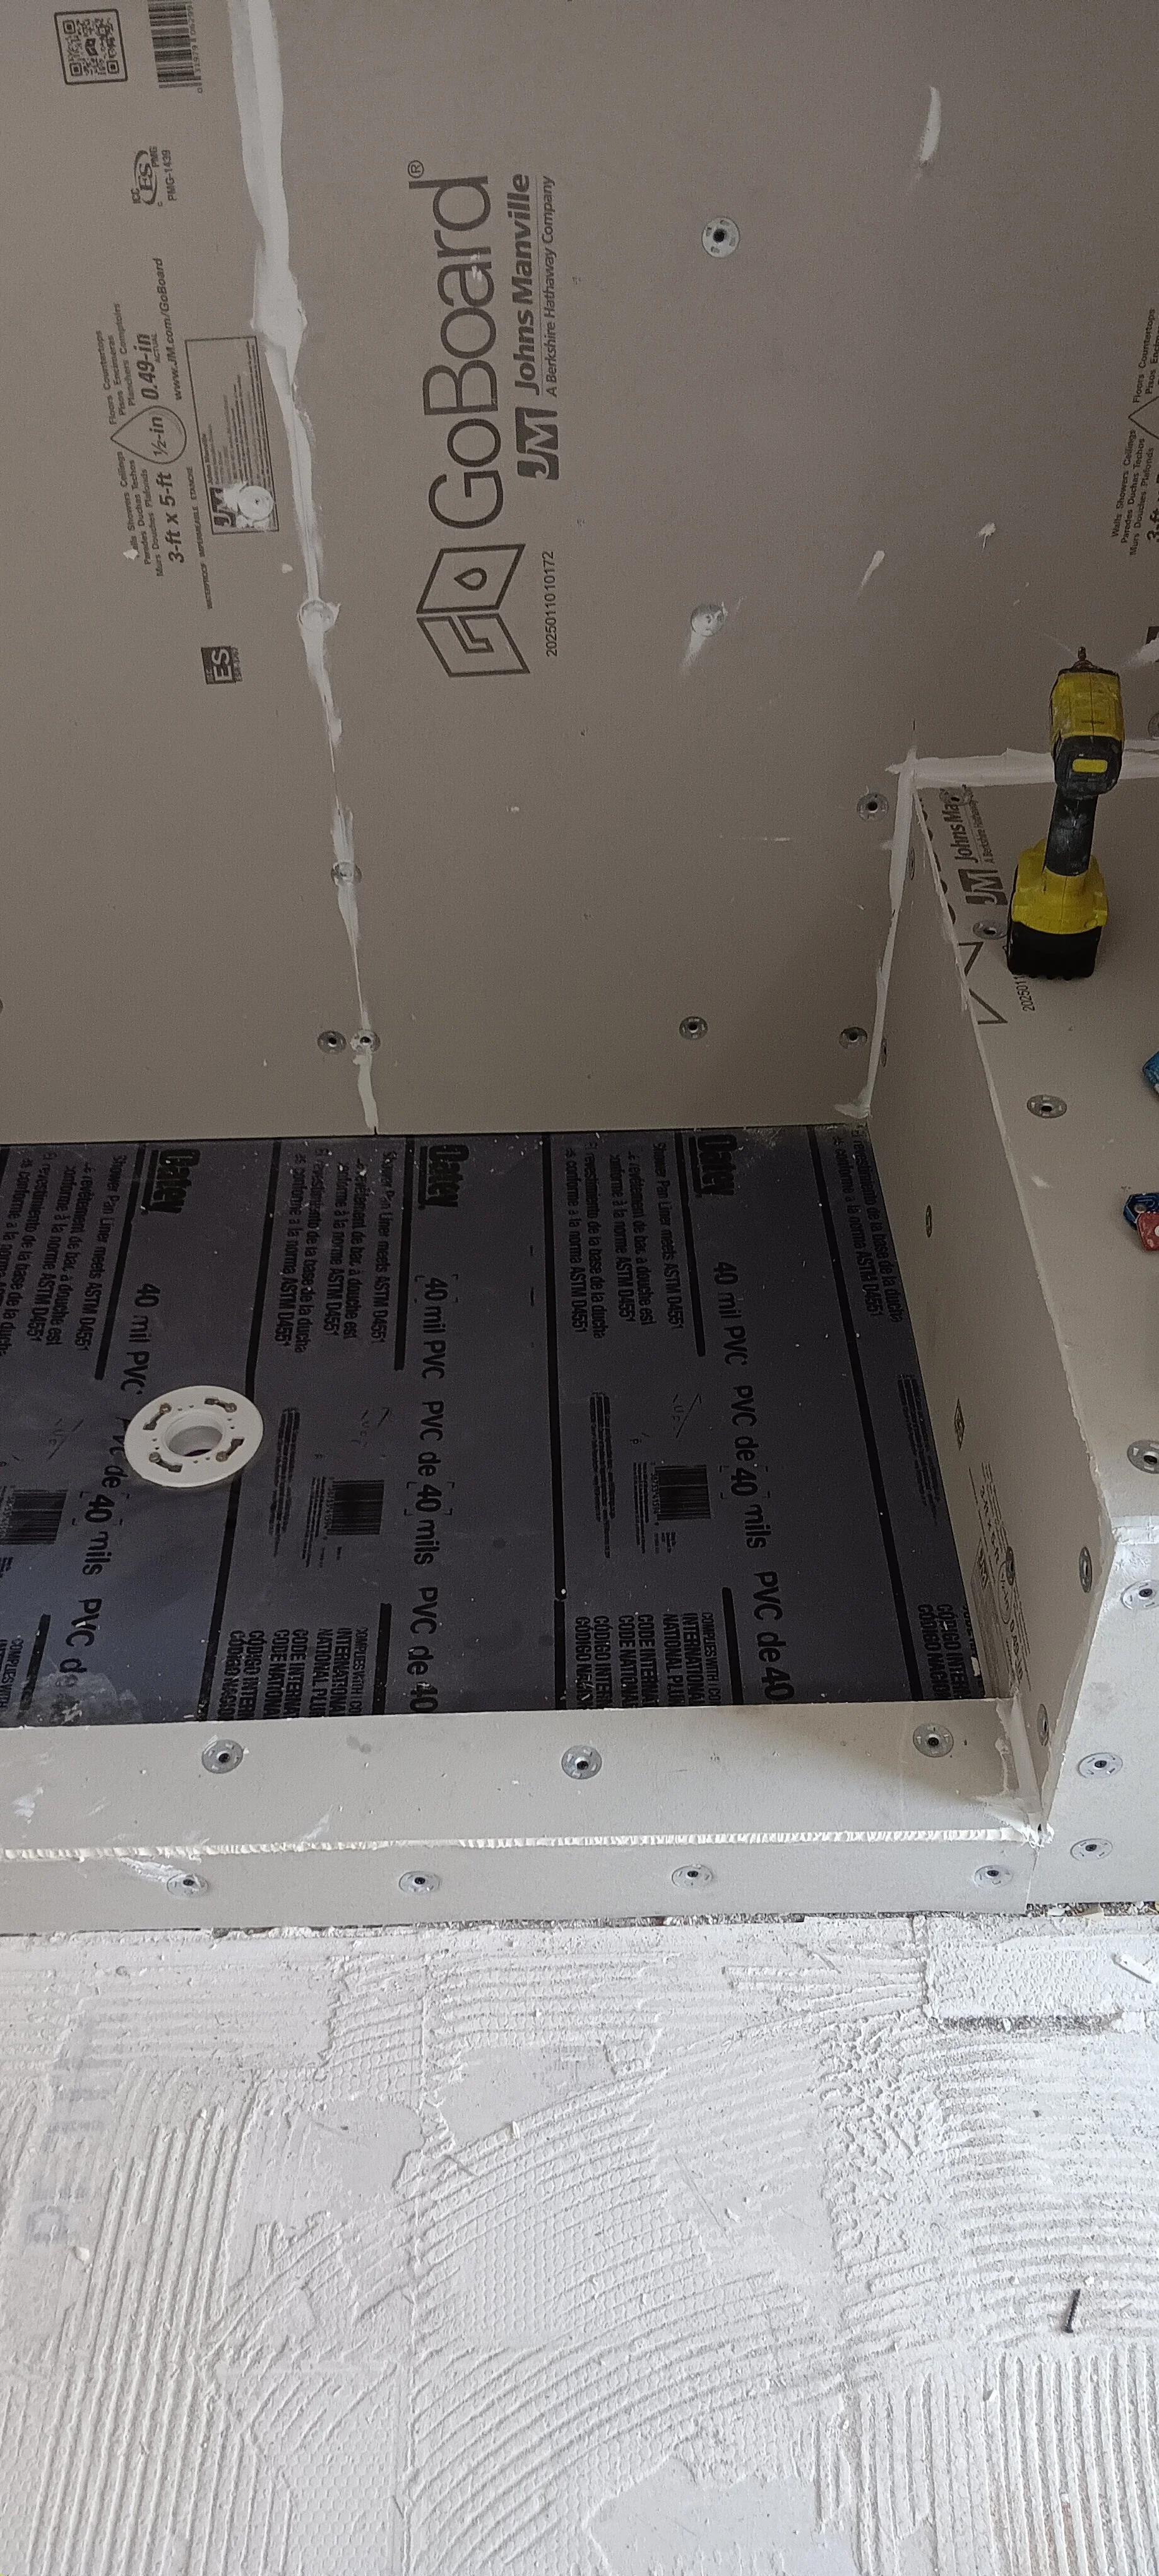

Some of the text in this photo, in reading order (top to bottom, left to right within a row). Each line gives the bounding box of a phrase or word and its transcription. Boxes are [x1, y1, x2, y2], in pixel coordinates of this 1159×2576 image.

[138, 164, 153, 191] ES
[507, 173, 540, 396] Johns Manville
[540, 175, 557, 397] A Berkshire Hathaway Company
[151, 333, 161, 363] ACTUAL
[152, 257, 183, 401] www.JM.com/GoBoard
[1132, 308, 1156, 403] Floors Countertops
[95, 330, 117, 426] Floors Countertops
[133, 333, 160, 401] 0.49-in
[129, 459, 138, 491] Techos
[514, 407, 559, 480] JM
[1132, 438, 1145, 469] Techos
[117, 451, 135, 531] Showers Ceilings
[134, 494, 145, 527] Duchas
[155, 471, 185, 563] 3-ft x 5-ft
[1111, 429, 1136, 537] Walls Showers Ceilings
[1127, 472, 1139, 505] Duchas
[1133, 491, 1147, 528] Douches
[211, 648, 233, 681] ES
[950, 825, 978, 863] Johns
[958, 868, 1008, 906] JM
[148, 1148, 201, 1213] Oatey
[425, 1145, 470, 1208] Oatey
[656, 1180, 671, 1199] Pan
[696, 1135, 738, 1196] Oatey
[613, 1208, 634, 1287] la norme ASTM
[658, 1202, 672, 1226] Liner
[3, 1235, 37, 1320] de la base de la
[34, 1224, 68, 1305] la norme ASTM
[51, 1236, 83, 1326] de douche
[75, 1195, 120, 1351] Pan Liner ASTM D4551
[279, 1277, 299, 1309] ASTM
[294, 1231, 321, 1353] de la ducha
[326, 1219, 349, 1299] la ASTM
[343, 1231, 366, 1339] de douche est
[371, 1212, 393, 1344] Liner ASTM D4551
[569, 1219, 588, 1333] la norma ASTM D4551
[587, 1221, 609, 1339] de la base de la ducha
[633, 1220, 654, 1306] de douche
[663, 1263, 682, 1294] ASTM
[855, 1251, 878, 1282] ASTM
[866, 1208, 905, 1323] de la base de la ducha
[121, 1283, 162, 1395] 40 mil PVC
[422, 1277, 449, 1380] 40 mil PVC
[667, 1296, 684, 1330] D4551
[713, 1263, 749, 1366] 40 mil PVC
[102, 1465, 129, 1488] de
[413, 1400, 445, 1565] PVC de 40 mils
[730, 1385, 772, 1549] PVC de 40 mils
[85, 1494, 115, 1523] 40
[82, 1531, 112, 1575] mils
[64, 1598, 104, 1647] PVC
[270, 1629, 290, 1662] CODE
[290, 1629, 309, 1661] CODE
[407, 1586, 439, 1712] PVC de 40
[618, 1615, 636, 1648] CODE
[638, 1614, 655, 1647] CODE
[663, 1614, 682, 1673] NATIONAL
[701, 1613, 719, 1681] COMPLIES WITH
[752, 1570, 795, 1701] PVC de 40
[312, 1628, 333, 1687] NATIONAL
